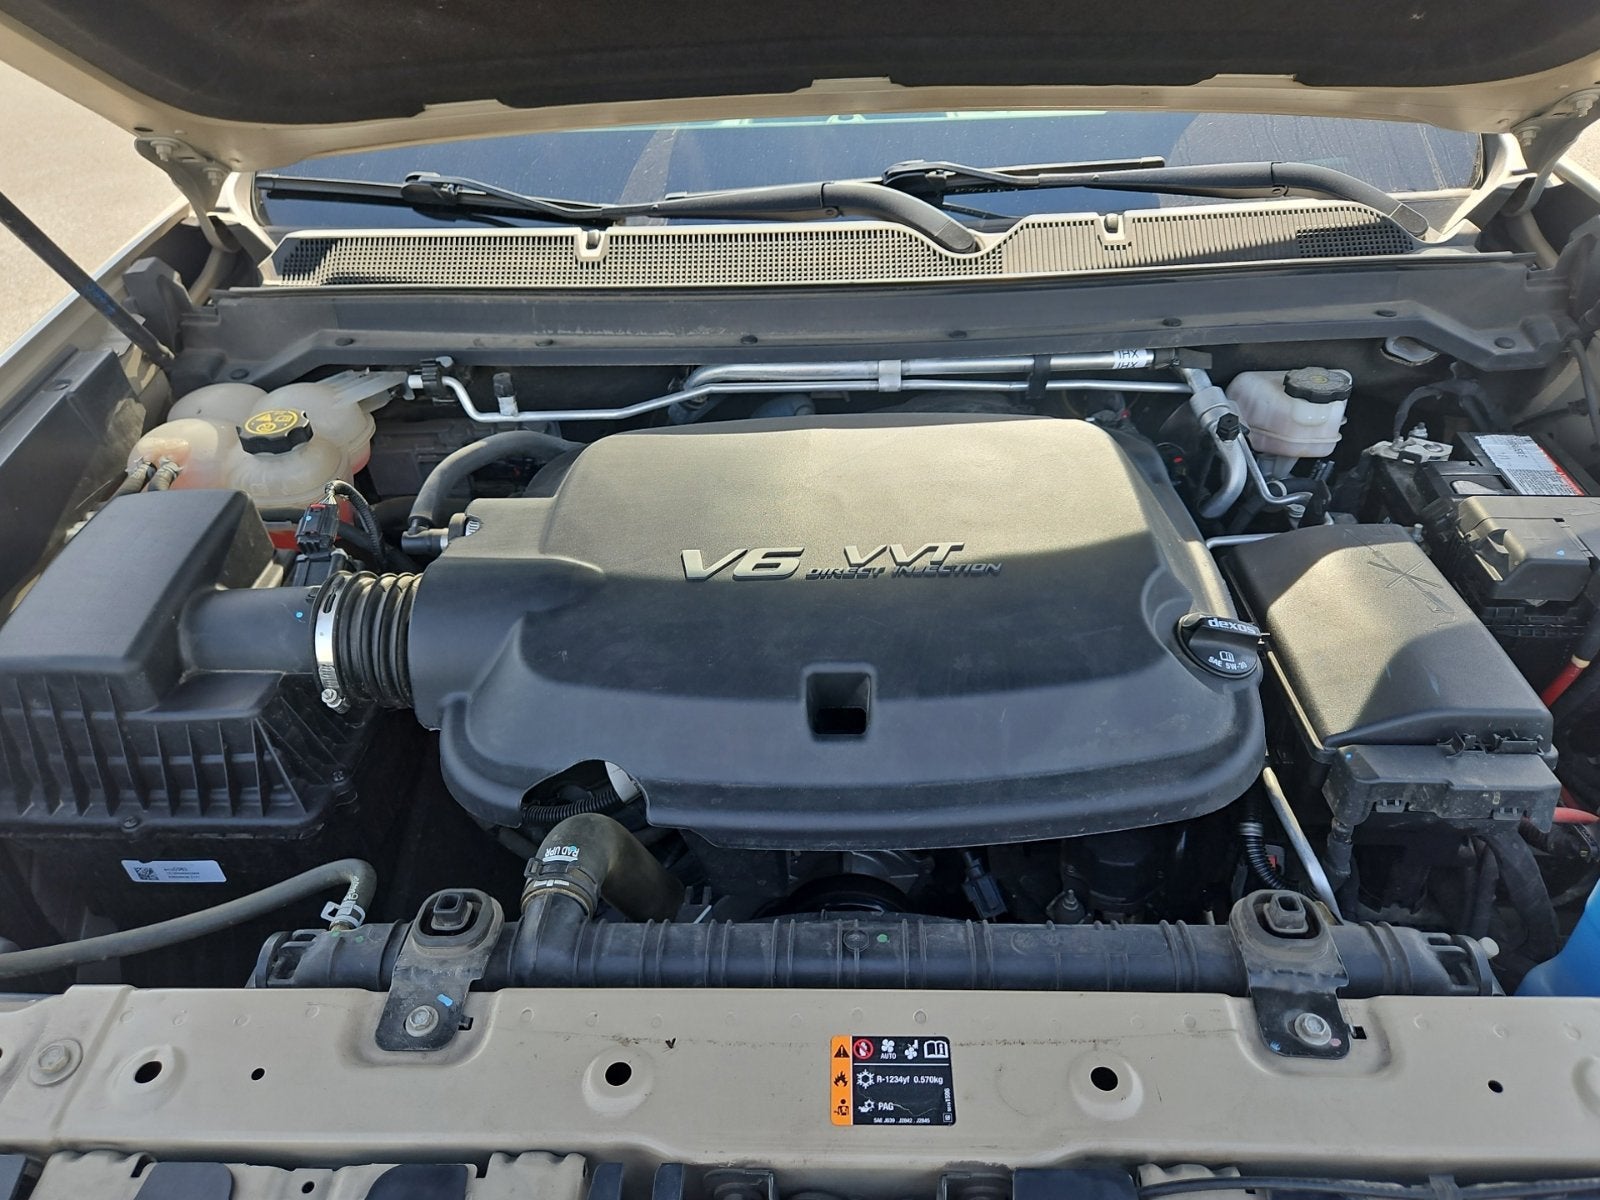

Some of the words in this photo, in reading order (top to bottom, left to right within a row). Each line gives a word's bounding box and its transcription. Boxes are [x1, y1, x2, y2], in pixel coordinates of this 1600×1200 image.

[681, 547, 804, 581] V6
[844, 541, 965, 566] VVT
[805, 566, 885, 580] DIRECT
[890, 562, 1003, 579] INJECTION
[1207, 618, 1257, 635] dexos
[1208, 656, 1223, 667] SAE
[544, 845, 561, 857] UPR
[876, 1075, 910, 1085] R-1234yf
[913, 1075, 944, 1085] 0.570kg
[878, 1102, 894, 1111] PAG
